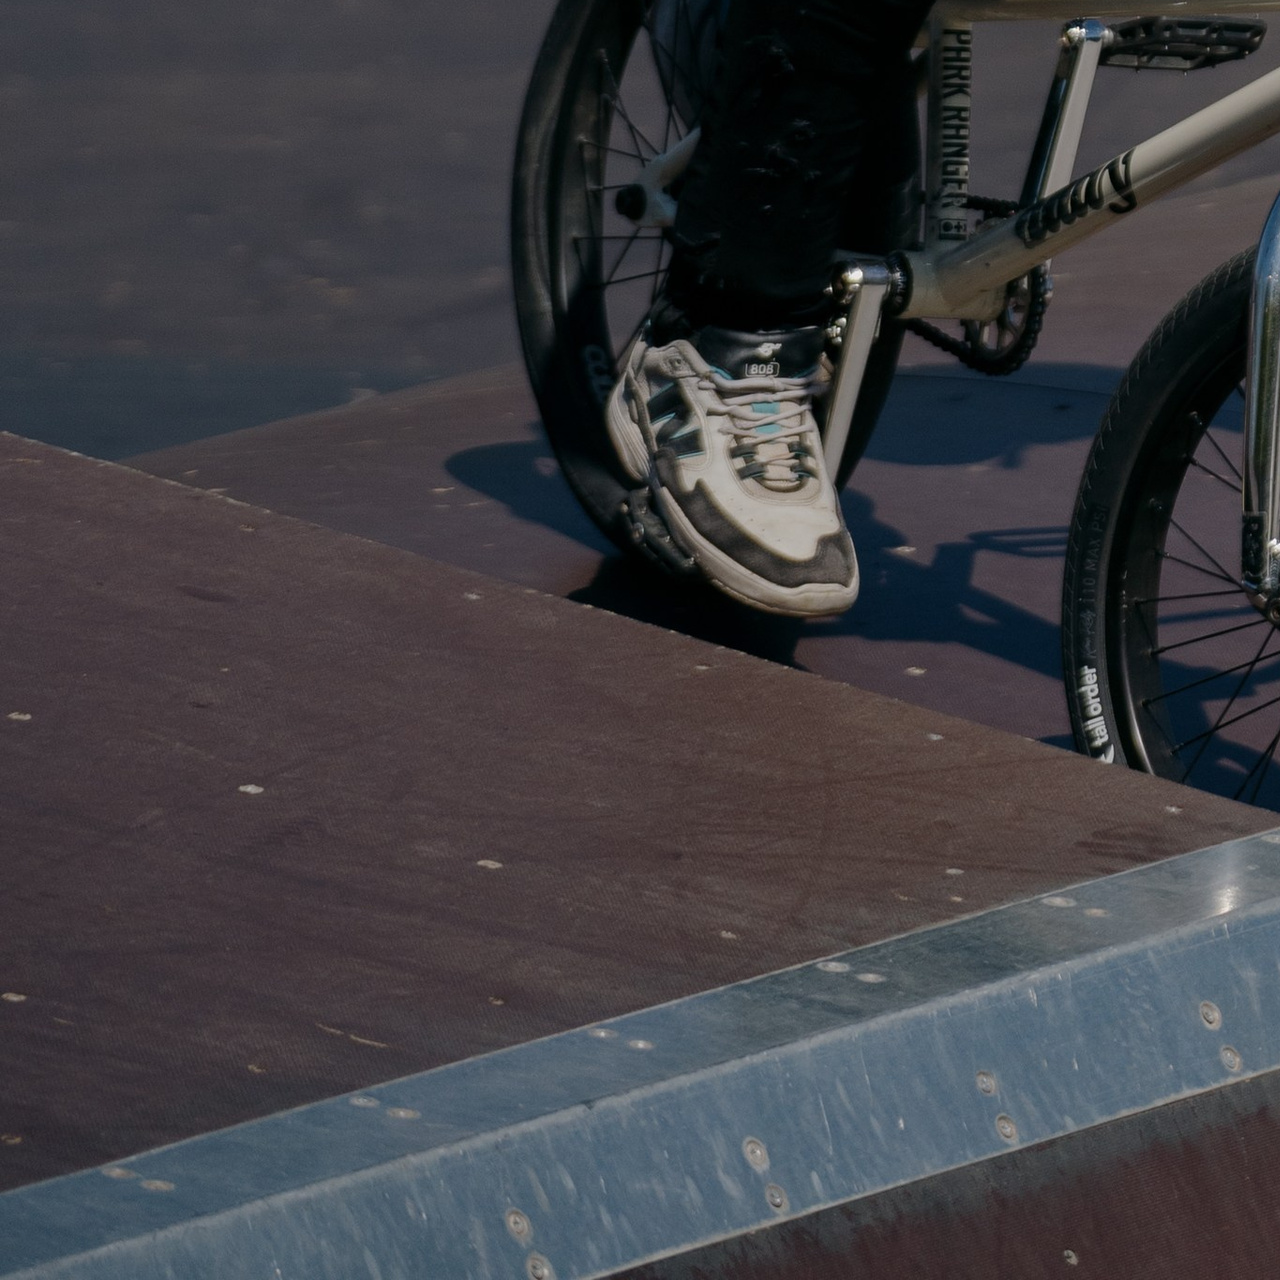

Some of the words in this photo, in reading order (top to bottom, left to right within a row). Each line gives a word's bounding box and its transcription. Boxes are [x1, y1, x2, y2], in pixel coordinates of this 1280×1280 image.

[943, 29, 973, 99] PARK
[1079, 665, 1102, 715] order
[1084, 715, 1110, 748] tall
